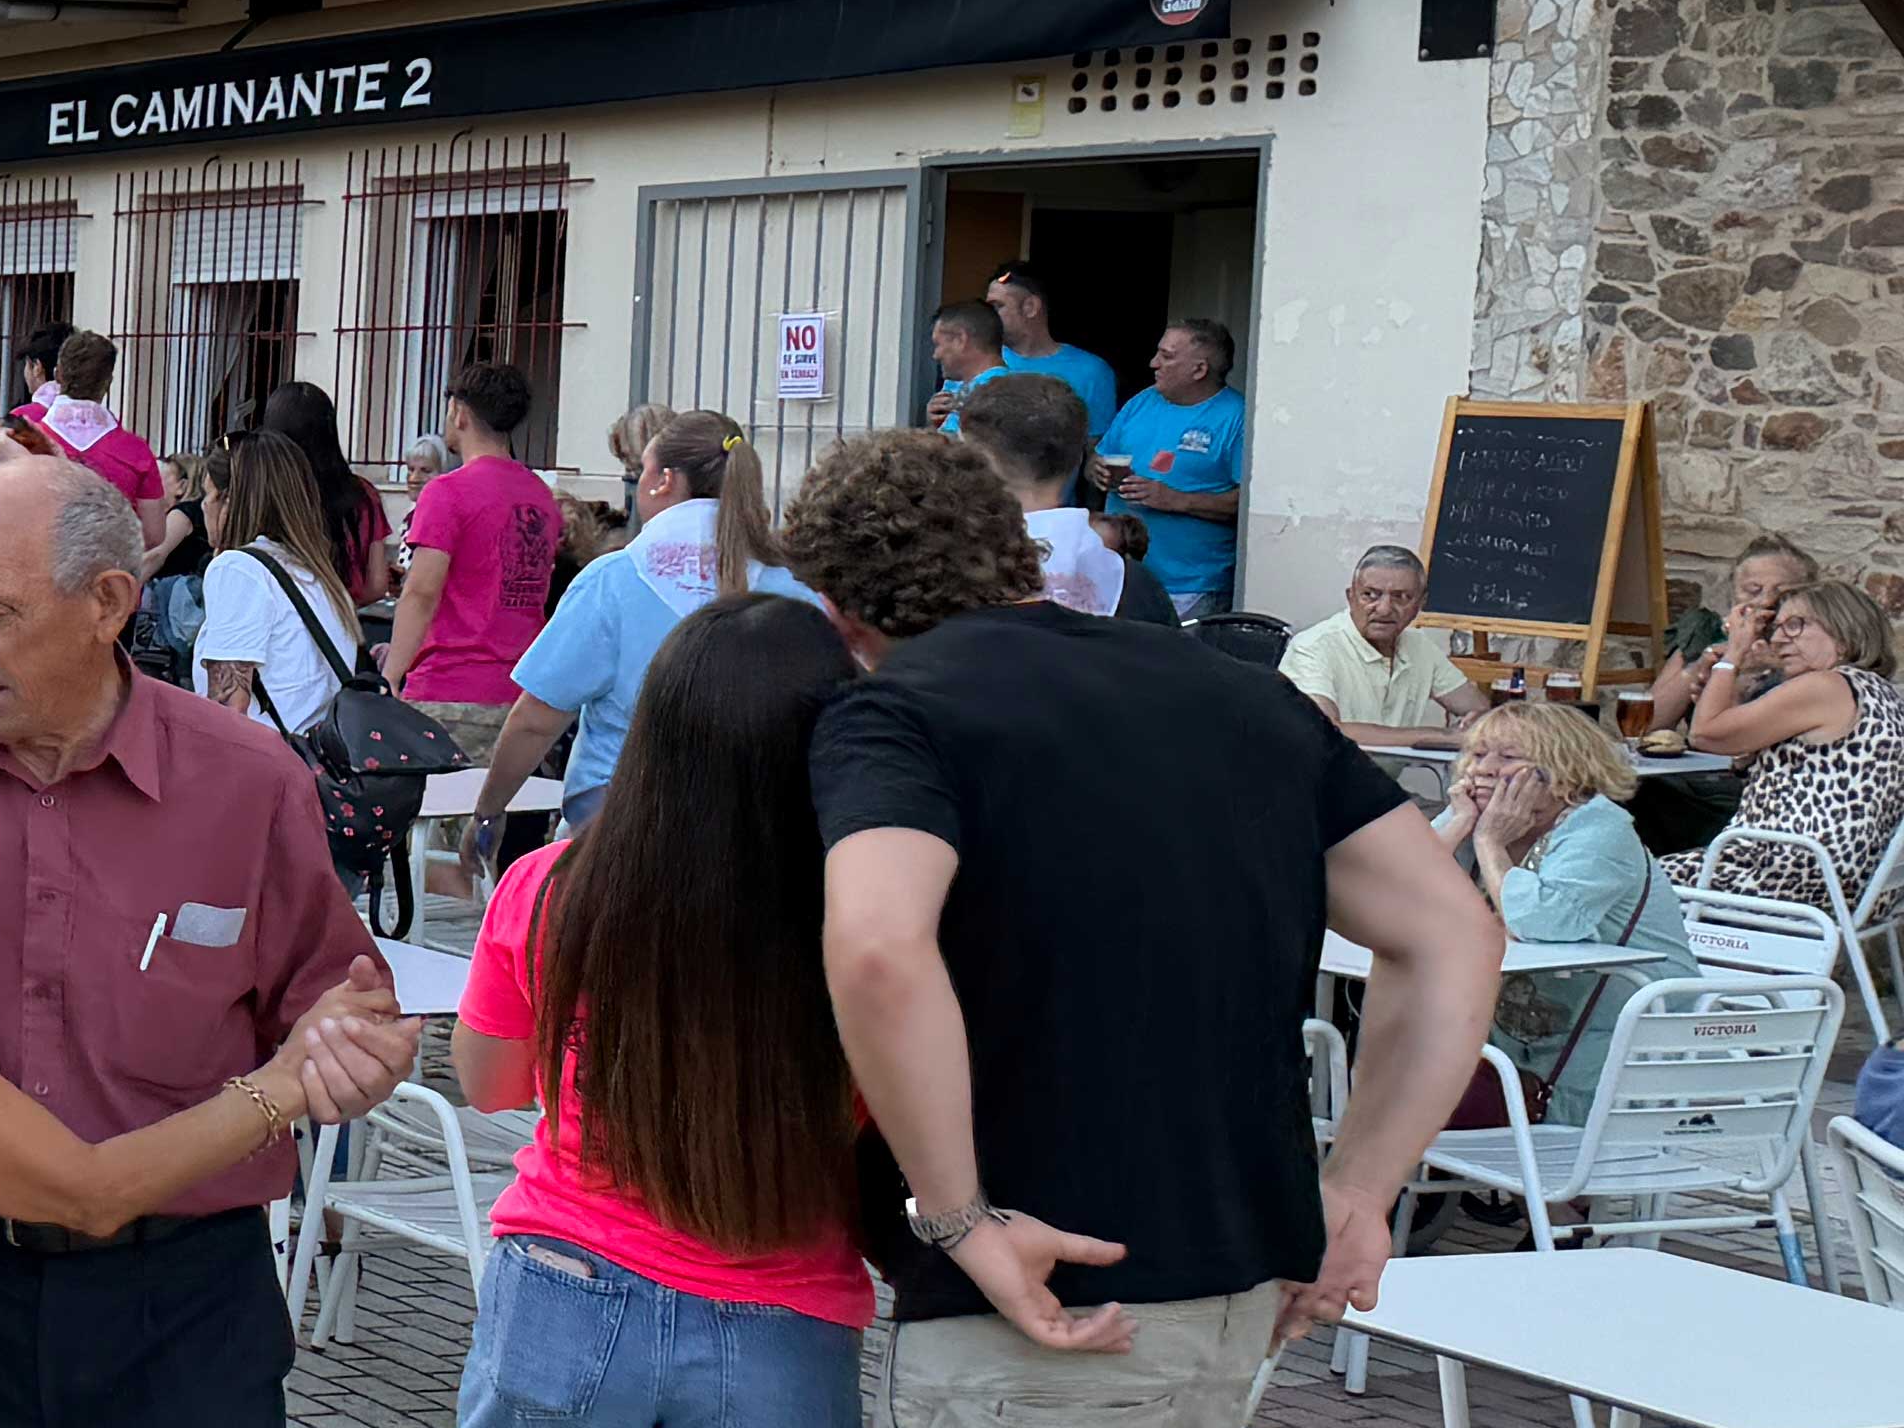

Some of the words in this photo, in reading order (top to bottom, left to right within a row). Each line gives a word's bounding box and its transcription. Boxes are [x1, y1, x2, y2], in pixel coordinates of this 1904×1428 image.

[48, 99, 99, 145] EL
[110, 60, 390, 138] CAMINANTE
[400, 57, 433, 108] 2
[786, 325, 816, 351] NO
[1694, 1023, 1757, 1036] VICTORIA
